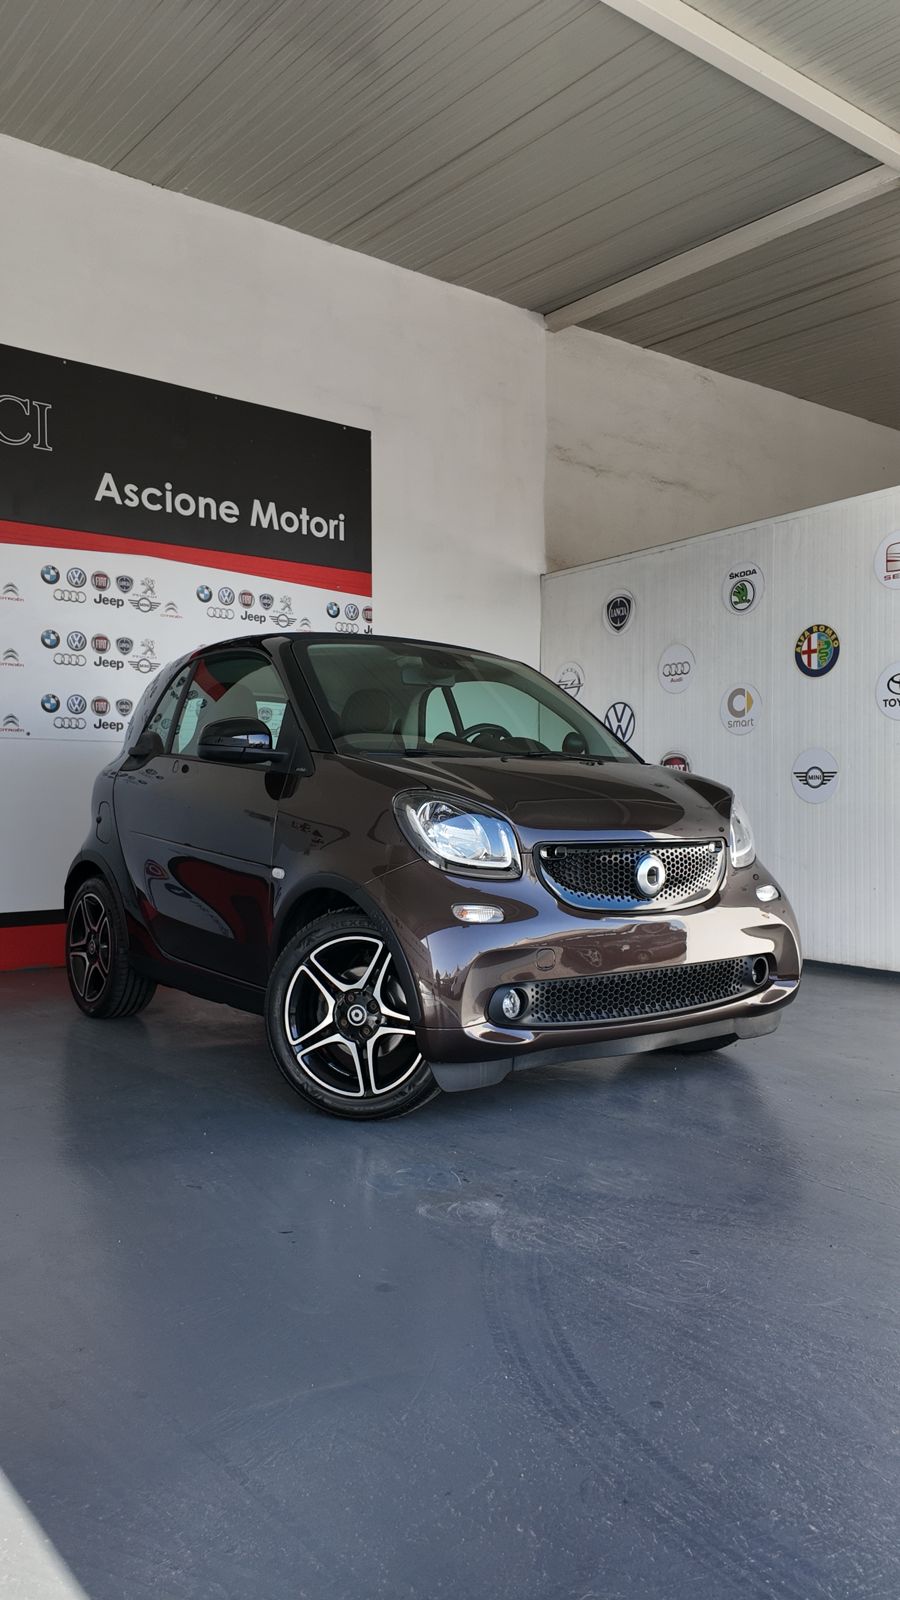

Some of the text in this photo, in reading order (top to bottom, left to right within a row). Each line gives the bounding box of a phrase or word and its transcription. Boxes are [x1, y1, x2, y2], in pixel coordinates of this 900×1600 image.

[94, 472, 346, 542] Ascione Motori
[728, 568, 757, 580] ŠKODA
[94, 594, 124, 608] Jeep
[240, 611, 266, 624] Jeep
[795, 624, 840, 653] ALFA ROMEO
[94, 656, 124, 670] Jeep
[94, 719, 124, 732] Jeep
[727, 717, 754, 729] smart
